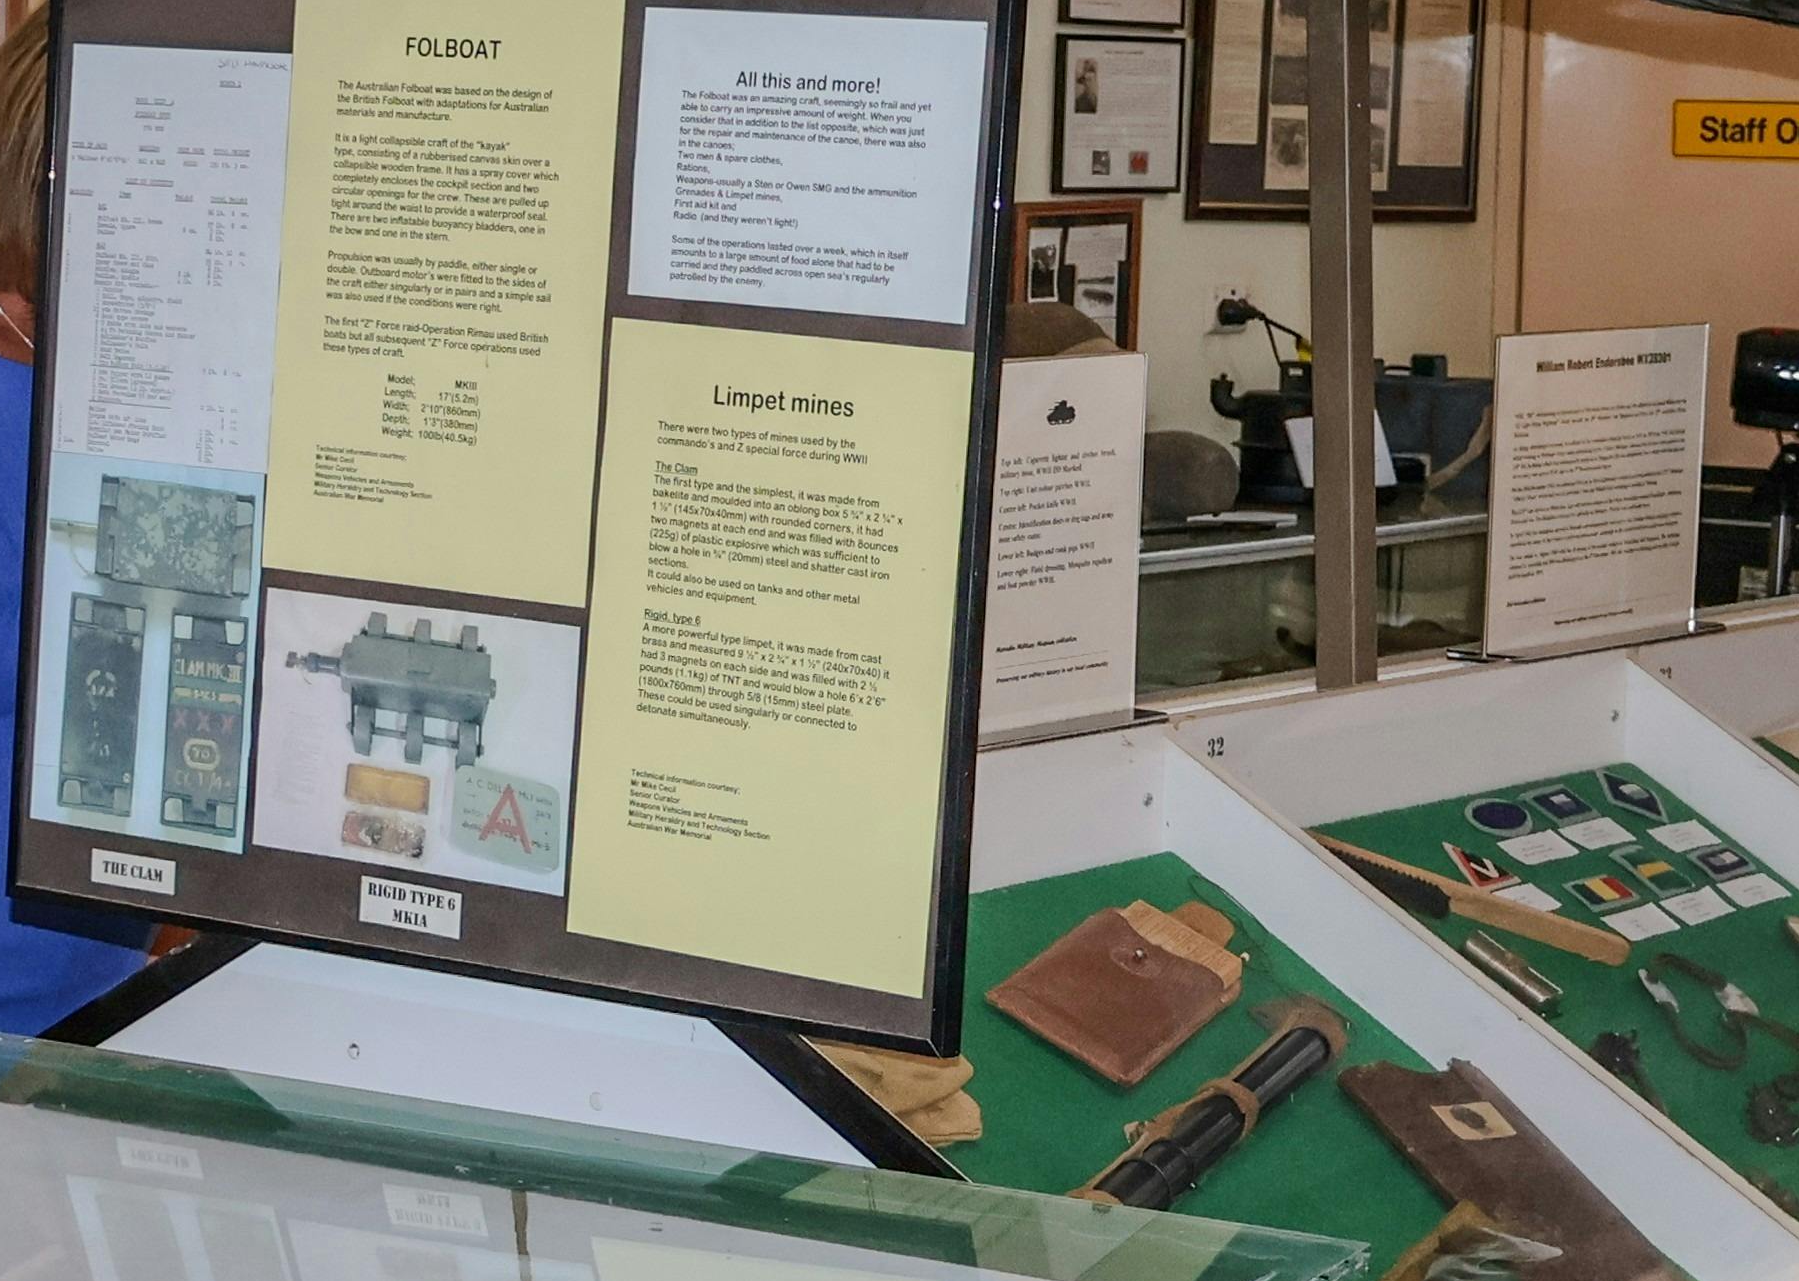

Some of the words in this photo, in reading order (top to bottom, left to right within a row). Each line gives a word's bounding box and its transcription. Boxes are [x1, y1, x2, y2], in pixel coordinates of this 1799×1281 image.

[406, 37, 502, 60] FOLBOAT
[337, 80, 353, 90] The
[355, 81, 399, 91] Australian
[400, 82, 433, 93] Folboat
[454, 86, 481, 95] based
[495, 87, 510, 97] the
[511, 88, 541, 101] design
[543, 89, 552, 99] of
[735, 71, 757, 87] All
[762, 72, 791, 89] this
[796, 74, 827, 91] and
[832, 77, 880, 93] more!
[336, 107, 375, 117] materials
[377, 108, 393, 118] and
[395, 110, 451, 120] manufacture.
[337, 93, 350, 102] the
[352, 94, 380, 104] British
[382, 95, 414, 106] Folboat
[415, 97, 434, 107] with
[436, 99, 487, 109] adaptations
[489, 100, 501, 110] for
[503, 101, 549, 112] Australian
[1699, 116, 1767, 143] Staff
[676, 174, 745, 189] Weapons-usually
[754, 178, 773, 188] Sten
[785, 181, 810, 191] Owen
[812, 182, 832, 192] SMG
[833, 185, 850, 194] and
[851, 185, 865, 195] the
[867, 188, 917, 198] ammunition
[324, 315, 340, 325] The
[342, 316, 358, 327] first
[360, 318, 374, 328] "Z"
[375, 319, 400, 330] Force
[496, 331, 518, 340] used
[519, 331, 548, 343] British
[713, 384, 785, 413] Limpet
[791, 393, 853, 417] mines
[658, 420, 684, 432] There
[686, 426, 709, 434] were
[711, 426, 729, 436] two
[730, 428, 756, 440] types
[758, 430, 768, 440] of
[769, 432, 798, 443] mines
[800, 436, 824, 446] used
[826, 437, 838, 449] by
[840, 438, 855, 449] the
[657, 436, 715, 449] commando's
[717, 442, 735, 451] and
[736, 442, 744, 452] Z
[745, 445, 779, 455] special
[782, 446, 807, 458] force
[809, 450, 840, 464] during
[842, 452, 867, 464] WWII
[655, 460, 673, 473] The
[674, 462, 698, 476] Clam
[654, 474, 671, 485] The
[673, 476, 691, 487] first
[693, 478, 713, 491] type
[715, 483, 733, 492] and
[736, 483, 750, 494] the
[753, 486, 795, 500] simplest,
[798, 490, 804, 500] it
[806, 493, 825, 502] was
[828, 495, 855, 505] made
[856, 496, 879, 508] from
[636, 702, 677, 717] detonate
[679, 710, 750, 729] simultaneously.
[1207, 737, 1224, 758] 32
[102, 860, 127, 876] THE
[130, 865, 162, 882] CLAM
[368, 882, 406, 901] RIGID
[410, 890, 444, 908] TYPE
[447, 898, 455, 910] 6
[392, 908, 427, 927] MKIA
